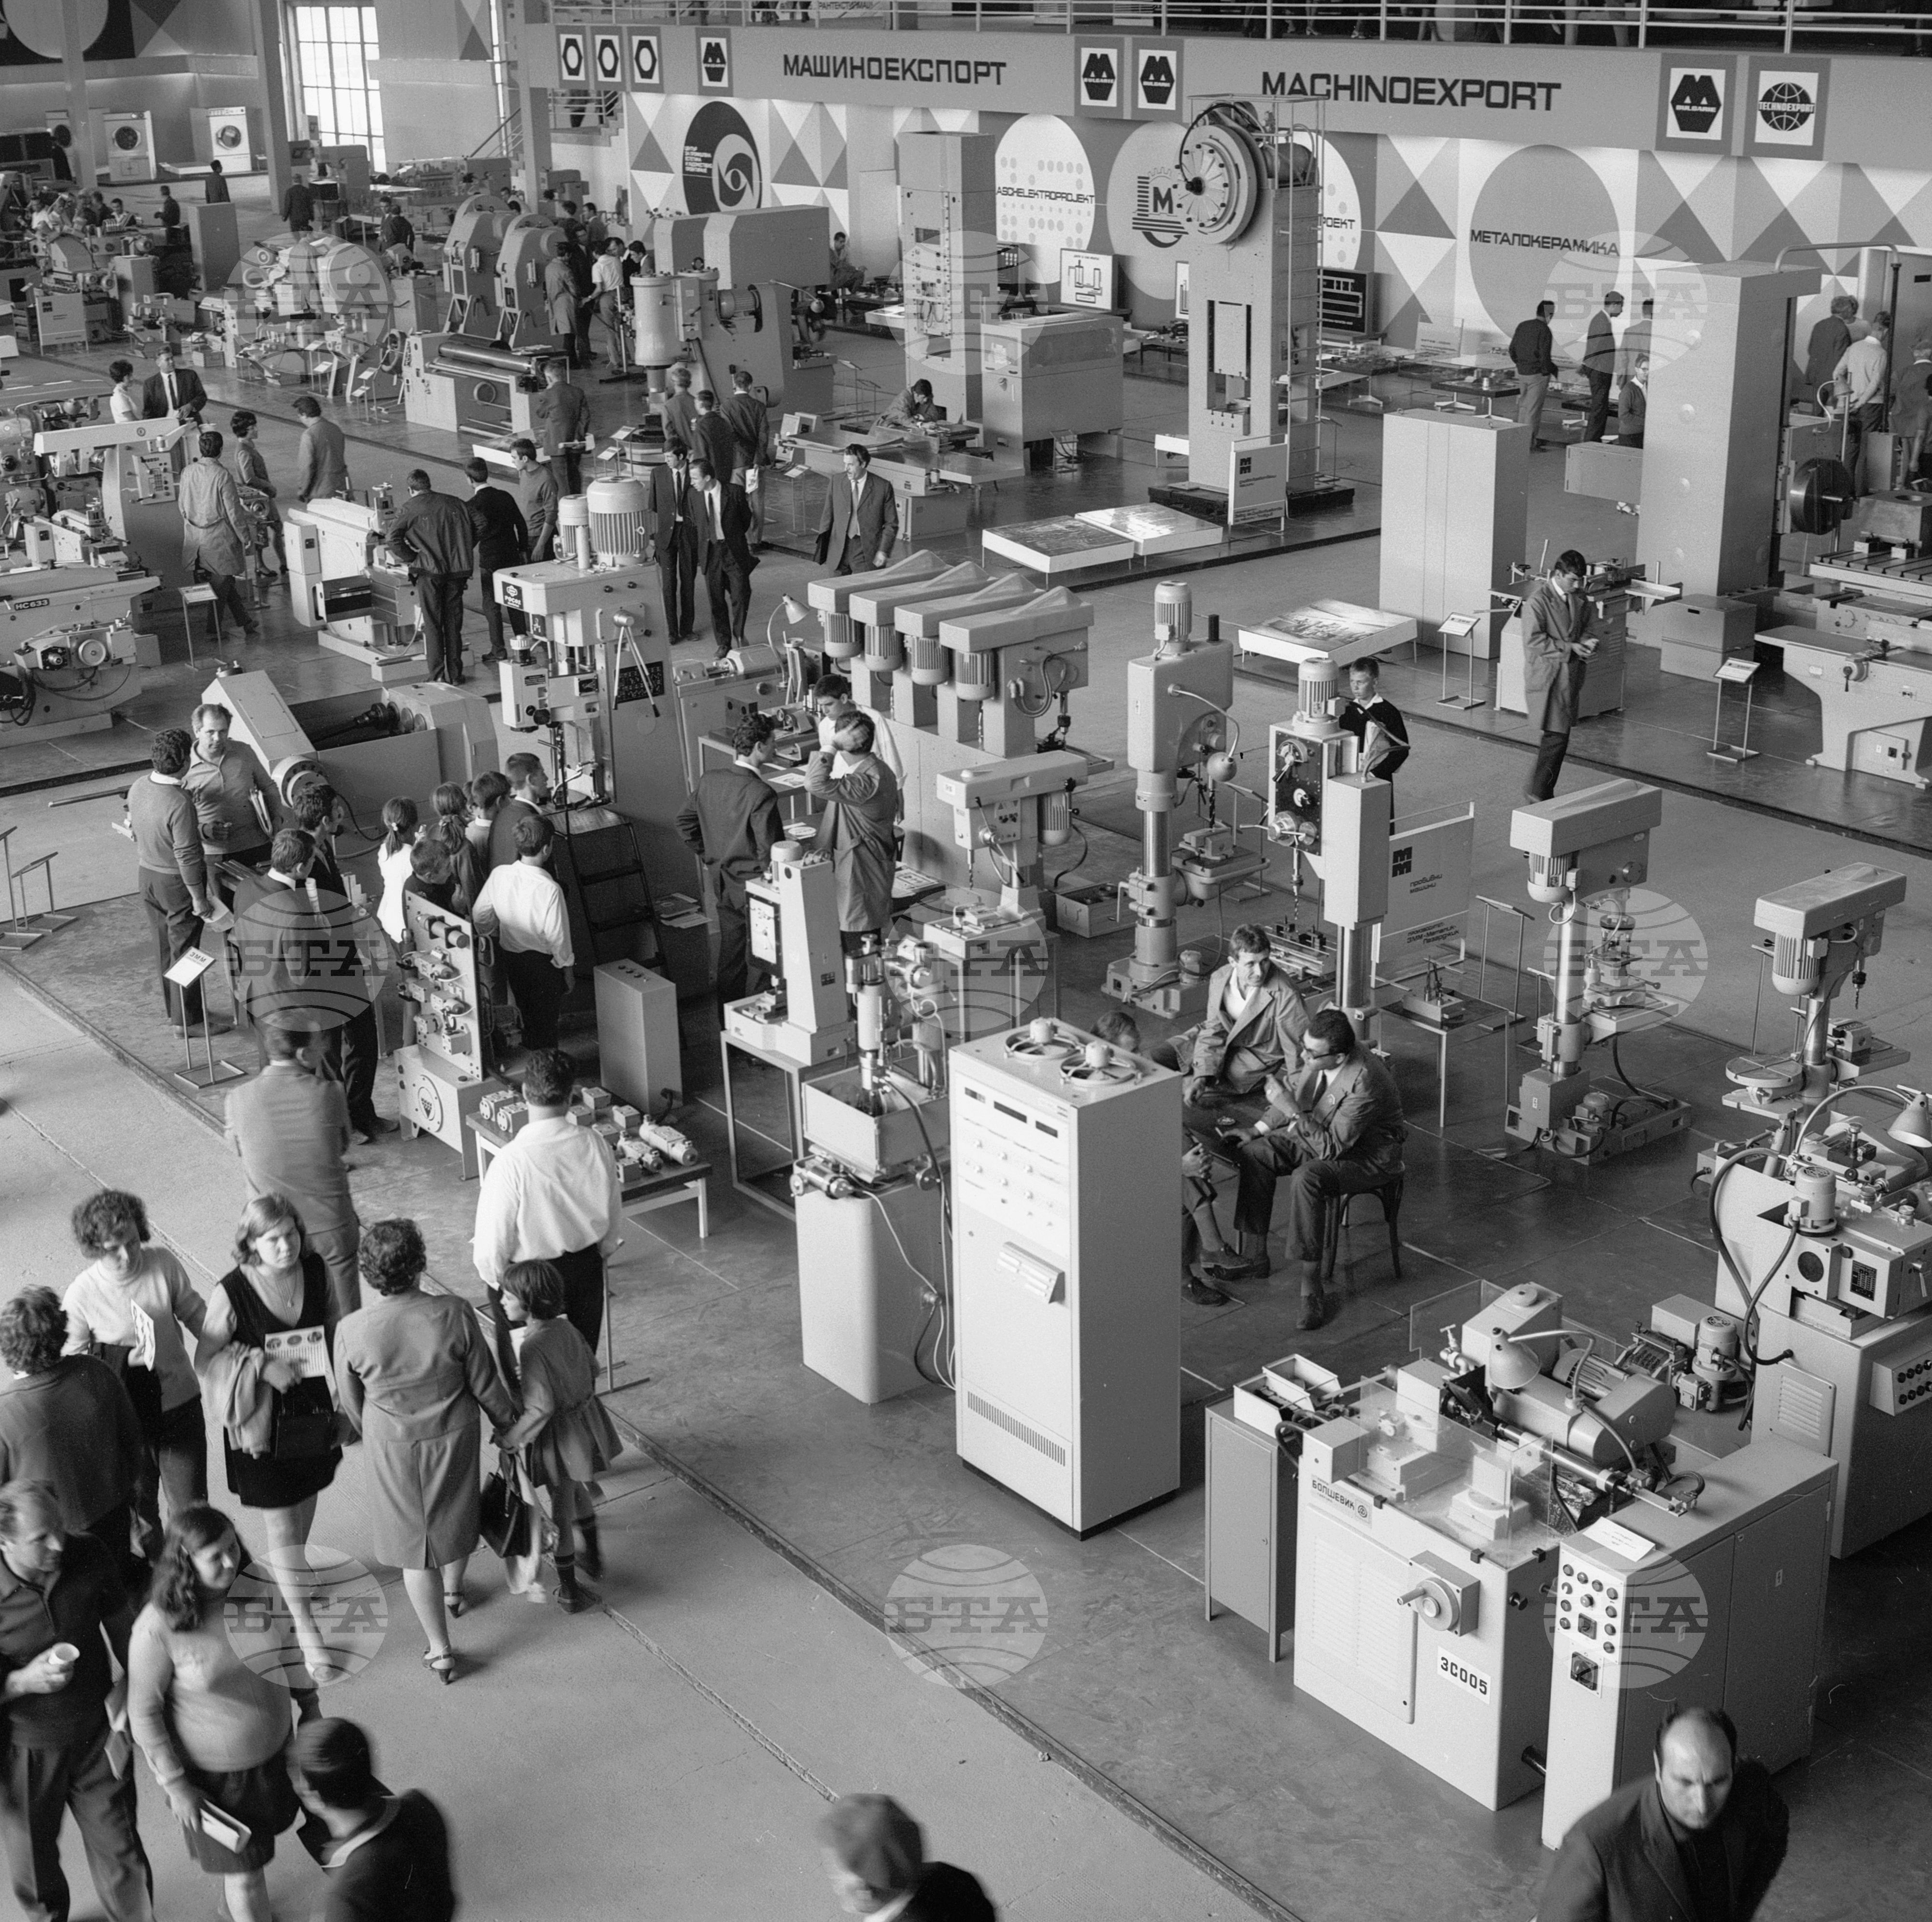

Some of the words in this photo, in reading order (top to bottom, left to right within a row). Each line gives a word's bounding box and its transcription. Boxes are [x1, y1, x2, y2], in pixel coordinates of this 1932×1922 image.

[783, 54, 1006, 85] МАШИНОЕКСПОРТ
[1262, 71, 1562, 111] MACHINOEXPORT
[1759, 101, 1815, 113] TECHNOEXPORT
[1471, 229, 1620, 256] МЕТАЛОКЕРАМИКА
[1312, 1480, 1354, 1511] БОЛШЕВИК
